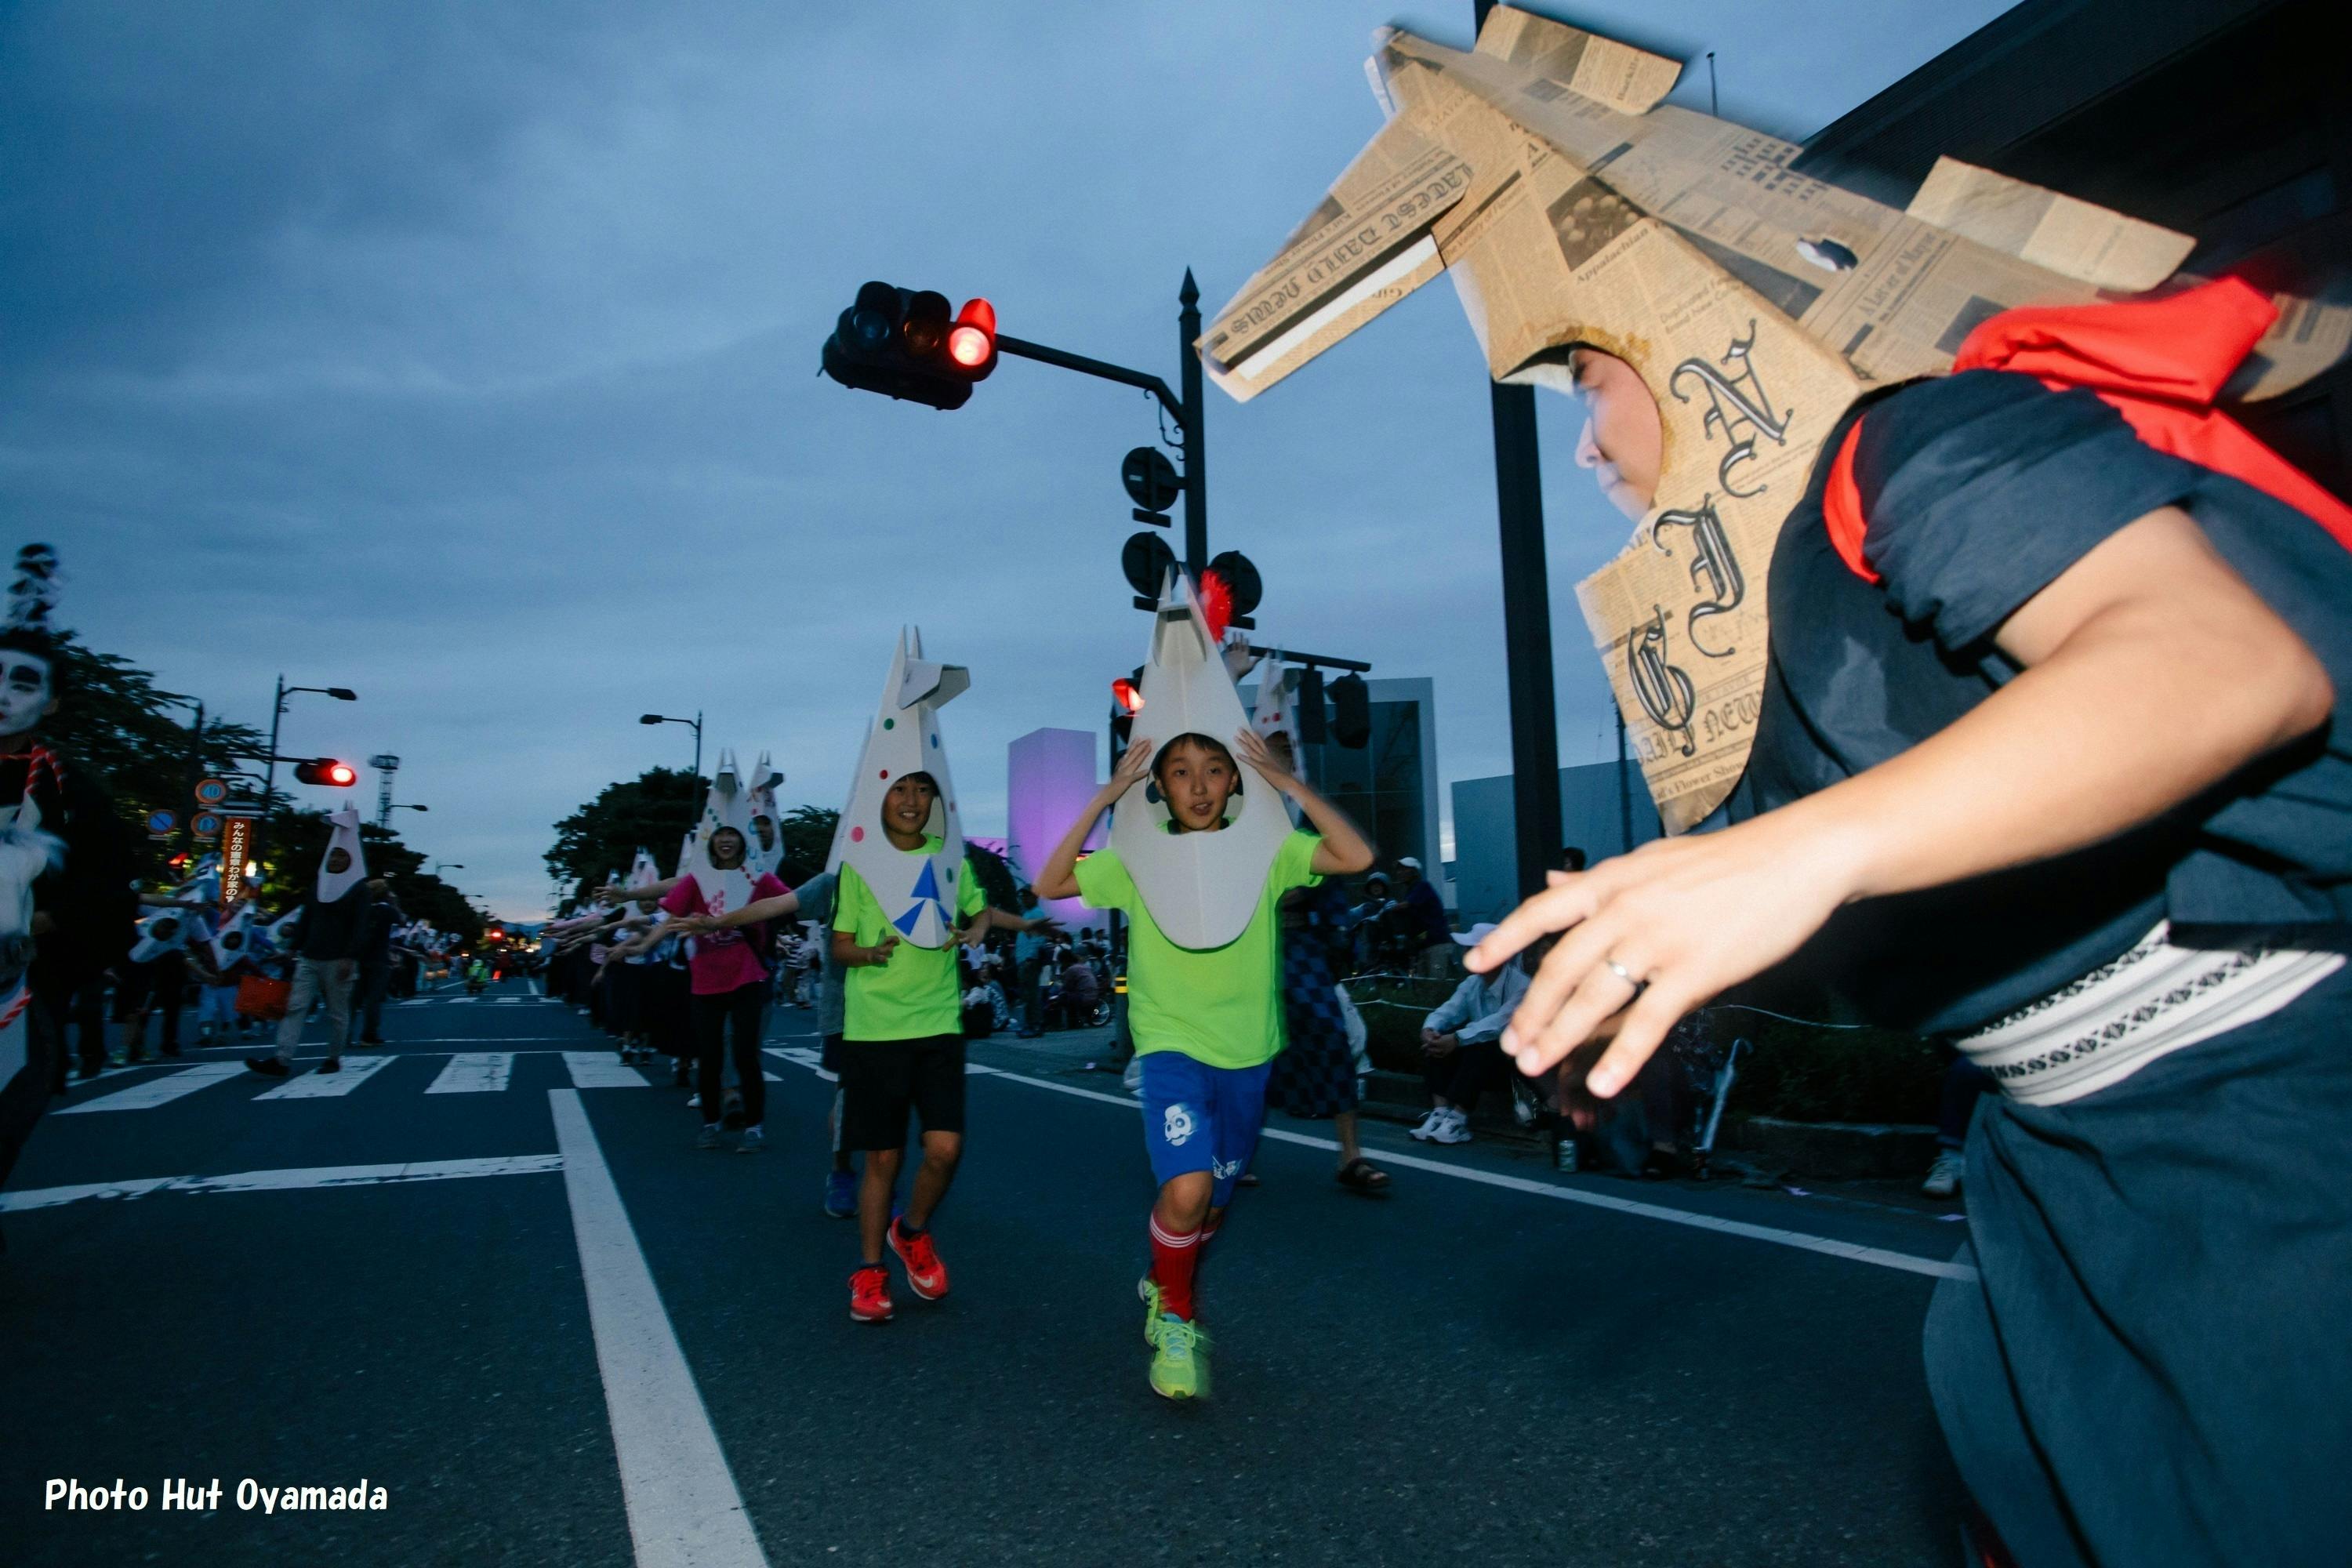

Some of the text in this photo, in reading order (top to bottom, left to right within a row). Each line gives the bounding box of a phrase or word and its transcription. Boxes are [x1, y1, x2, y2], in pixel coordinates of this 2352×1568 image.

[1379, 161, 1475, 233] LATEST
[1303, 224, 1380, 285] DAILY
[1230, 275, 1304, 333] NEWS
